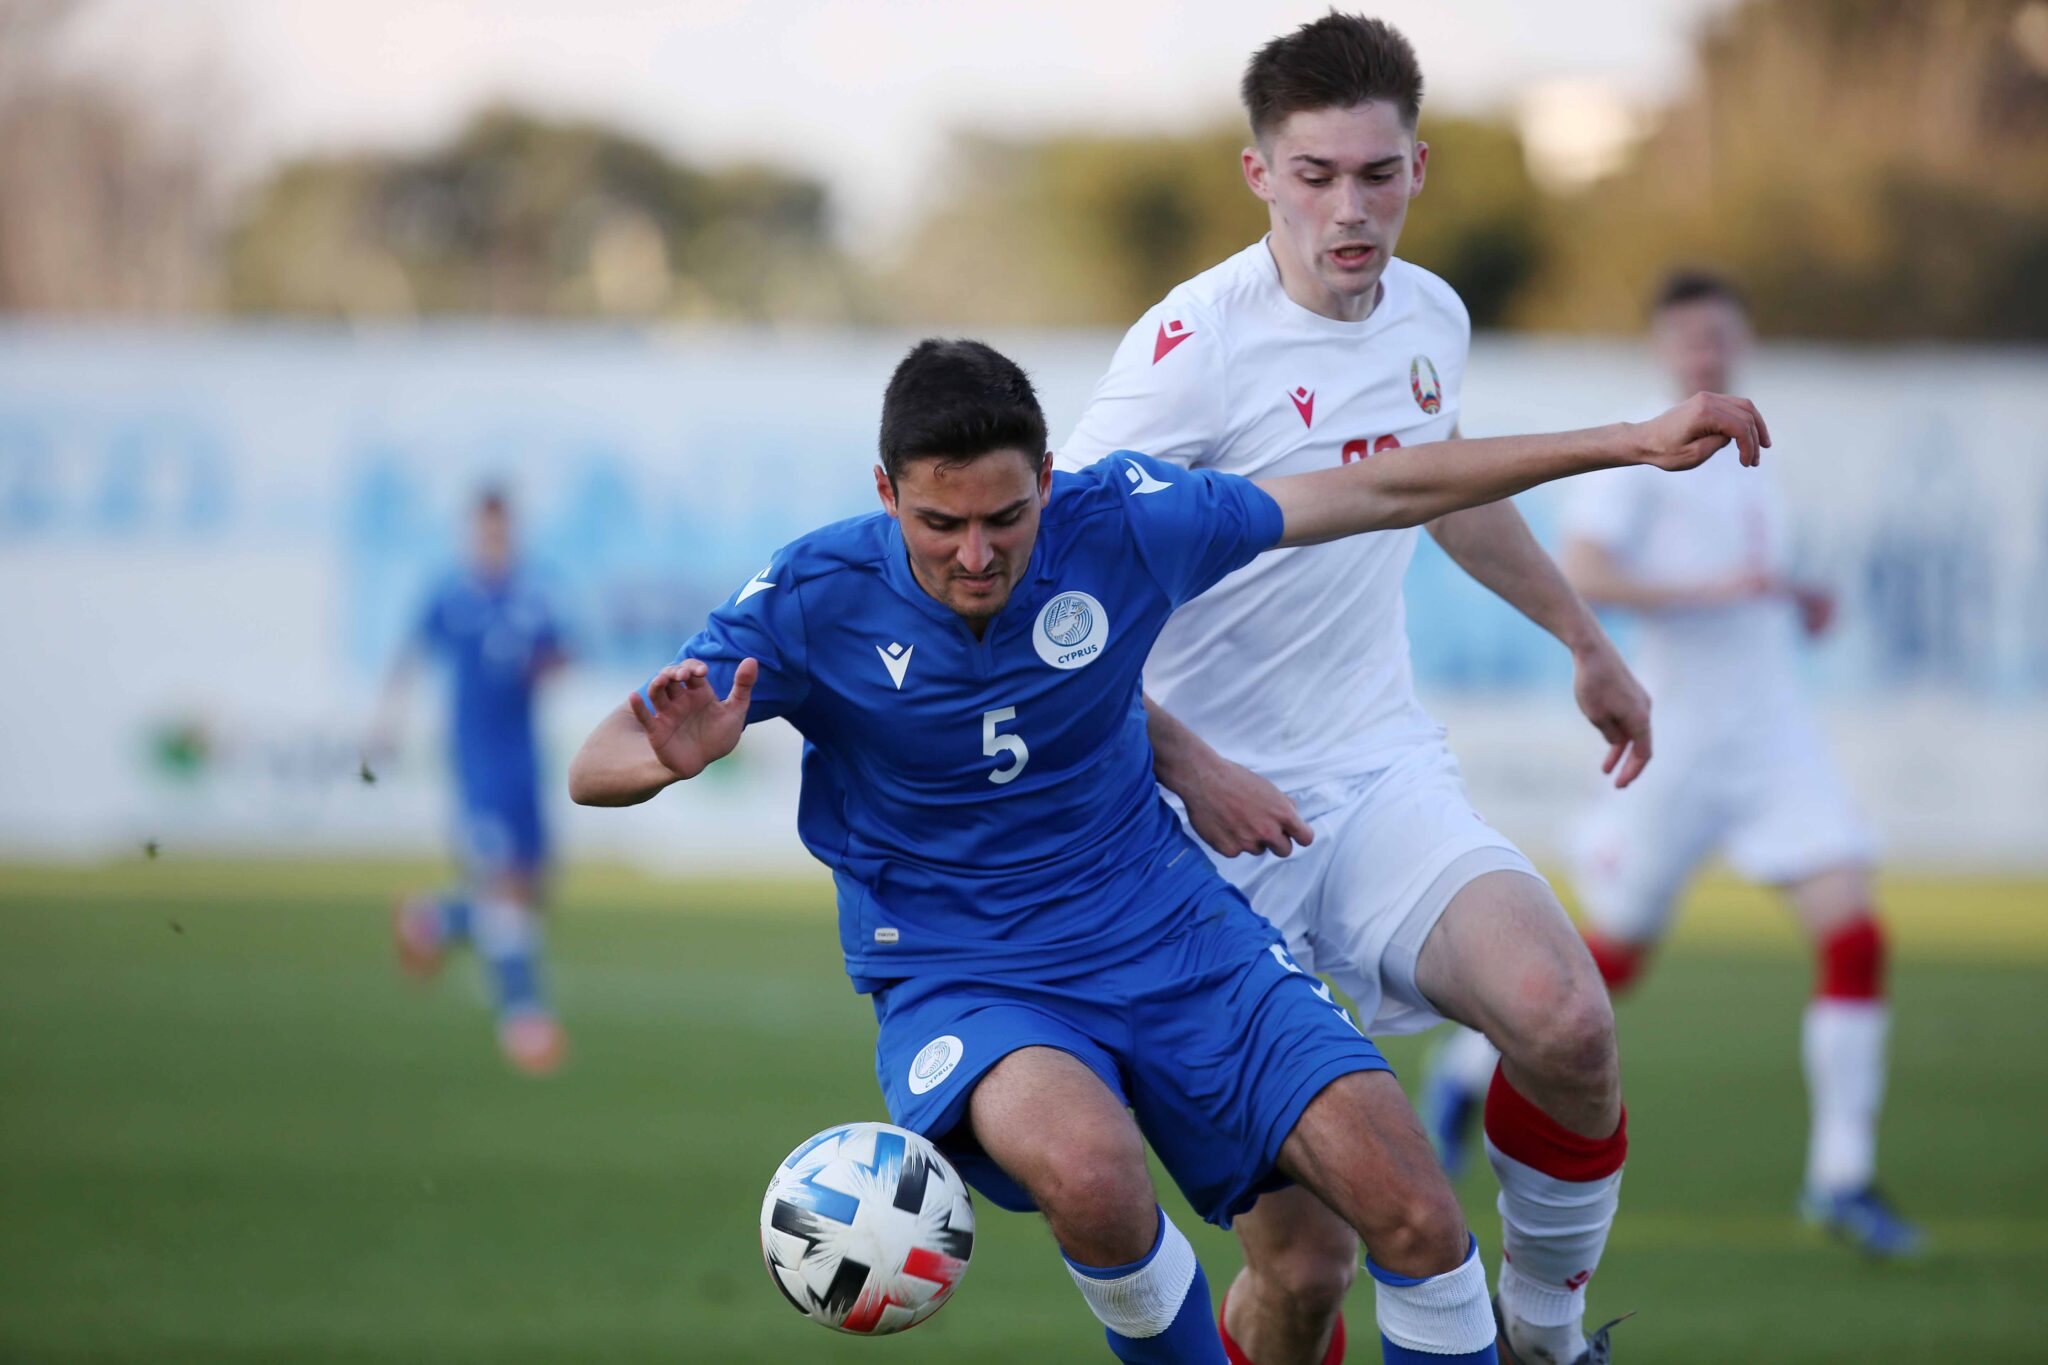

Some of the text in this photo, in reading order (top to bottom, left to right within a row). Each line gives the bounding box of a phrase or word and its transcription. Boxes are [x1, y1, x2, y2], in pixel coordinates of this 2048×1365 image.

[1057, 644, 1098, 664] CYPRUS
[982, 705, 1029, 784] 5
[925, 1063, 954, 1089] CYPRUS
